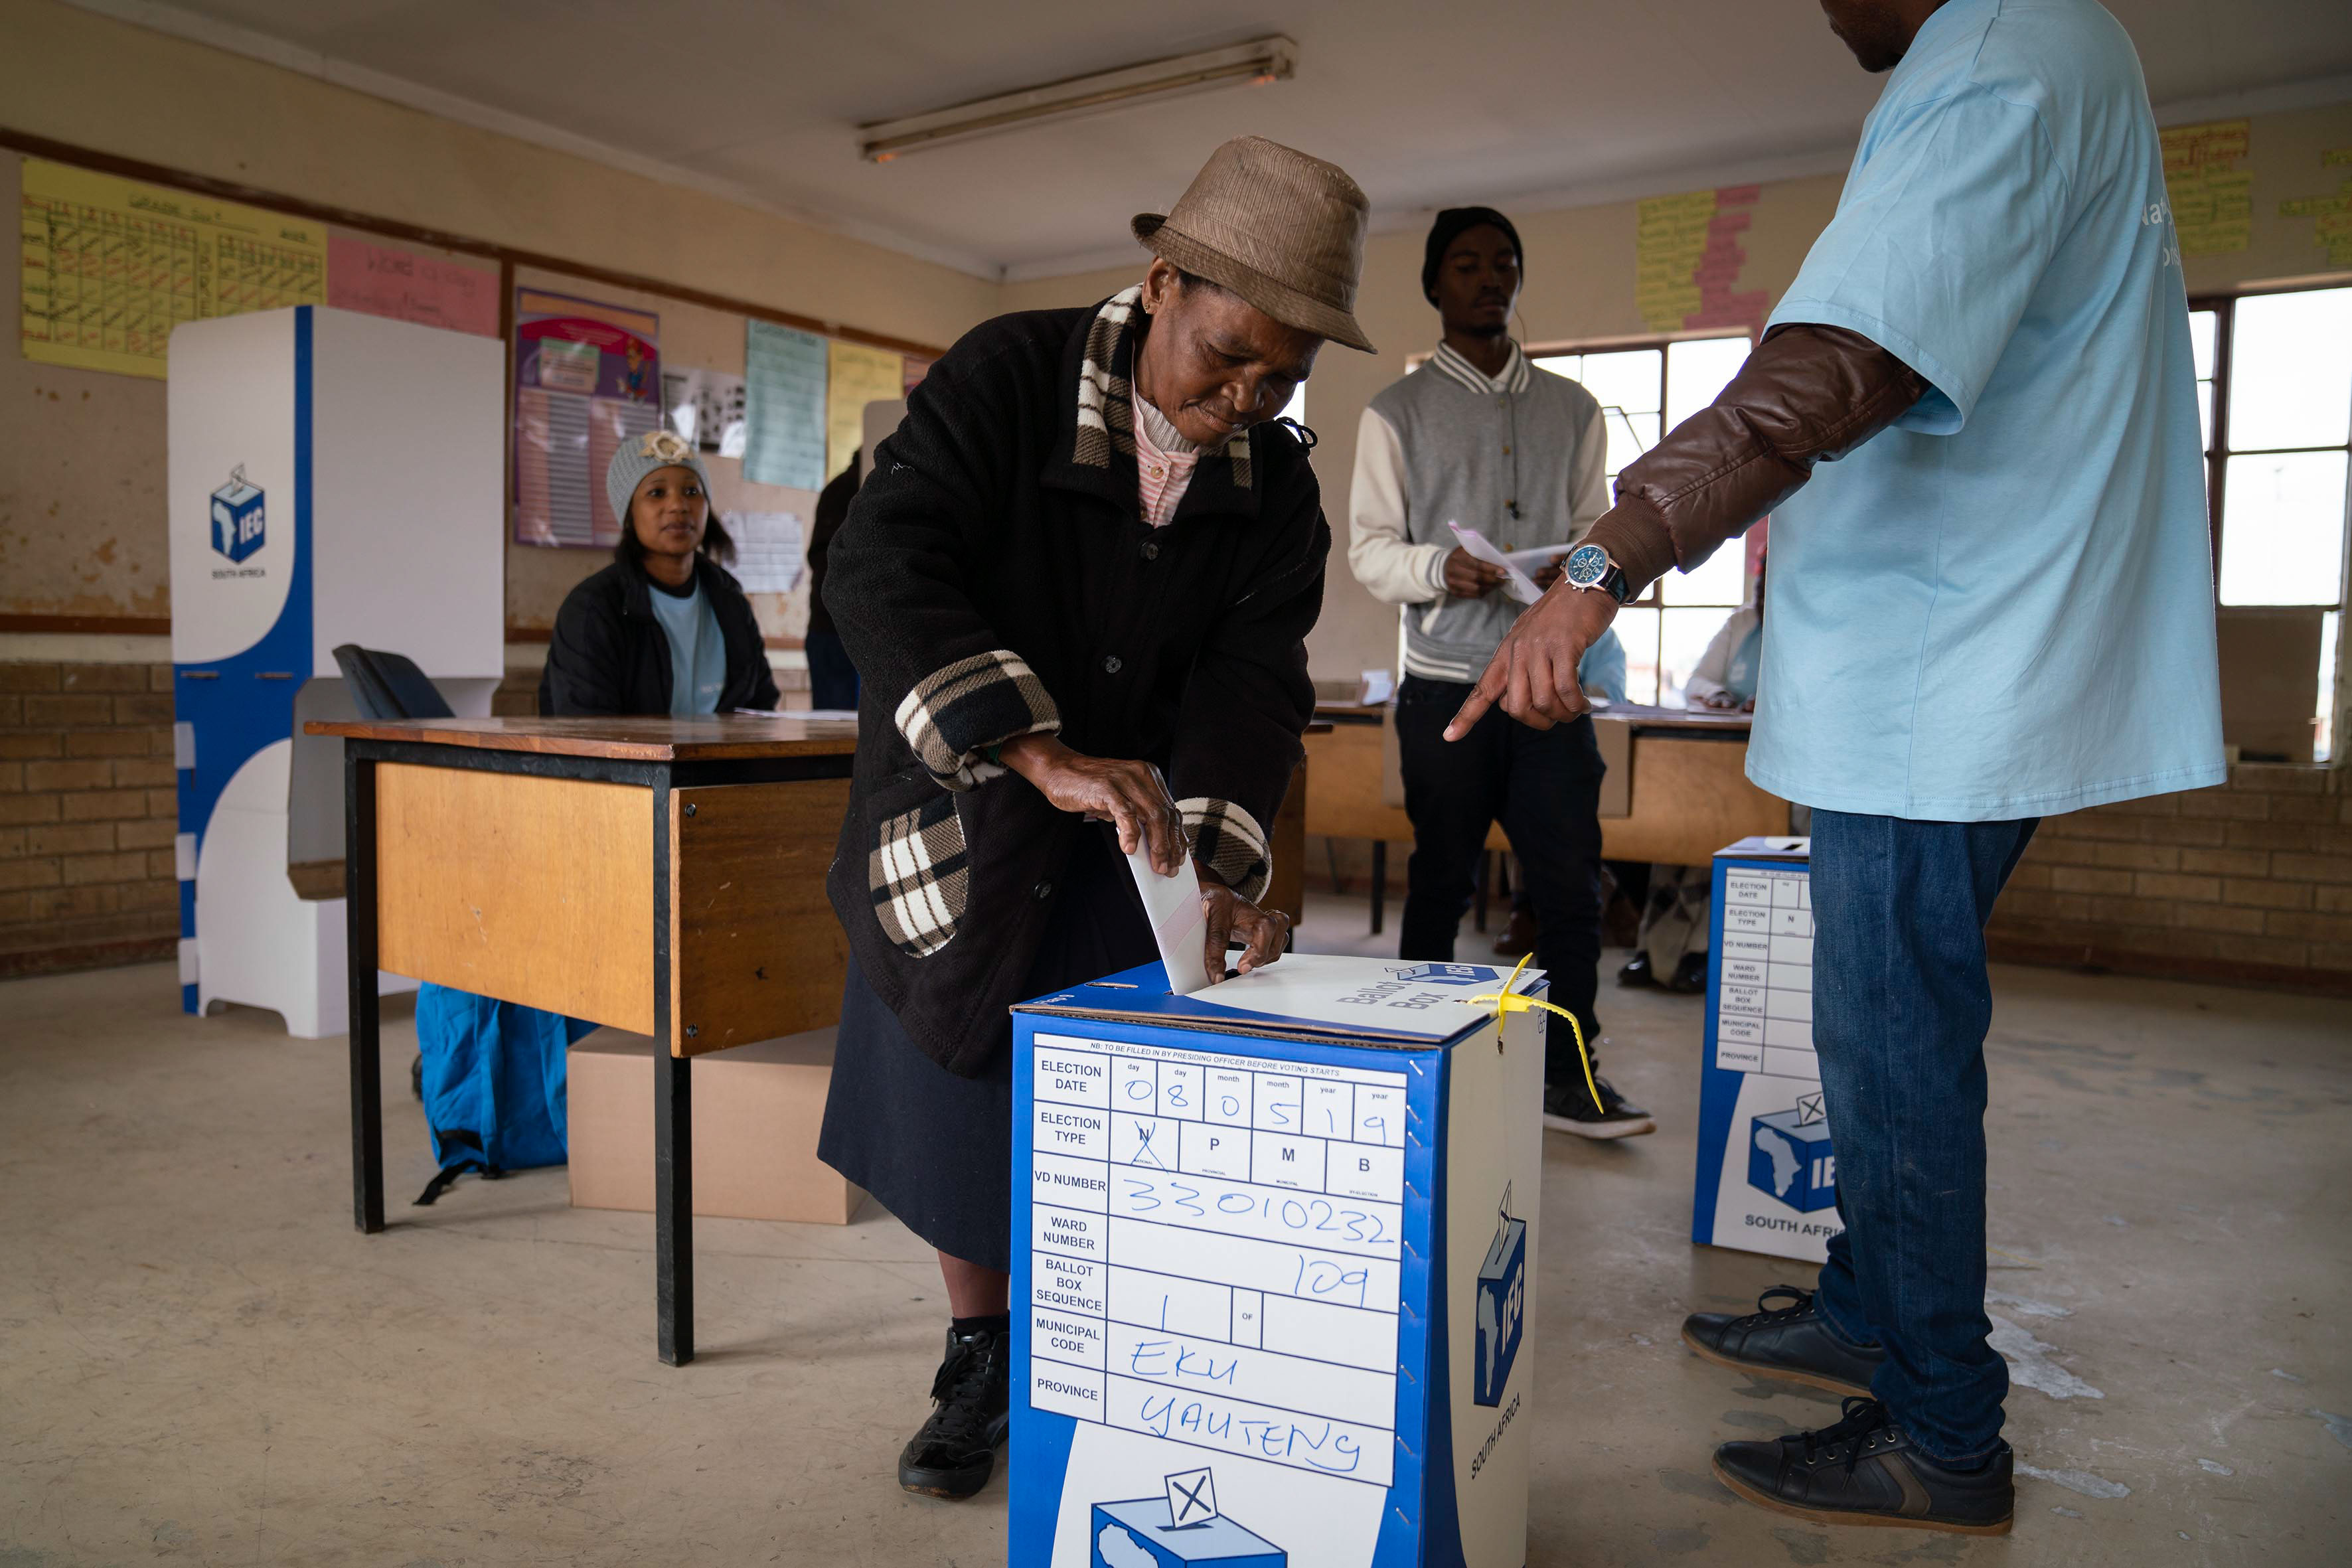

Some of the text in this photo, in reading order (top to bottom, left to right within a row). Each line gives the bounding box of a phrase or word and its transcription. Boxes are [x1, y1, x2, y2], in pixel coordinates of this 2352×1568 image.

[239, 506, 263, 544] IEC
[1731, 882, 1767, 890] ELECTION
[1736, 941, 1768, 951] NUMBER
[1445, 965, 1476, 976] IEC
[1336, 981, 1413, 1005] Ballot
[1386, 992, 1450, 1010] Box
[1729, 987, 1759, 996] BALLOT
[1723, 1004, 1763, 1014] SEQUENCE
[1721, 1019, 1761, 1029] MUNICIPAL
[1127, 1046, 1151, 1056] FILLED
[1172, 1052, 1212, 1062] PRESIDING
[1214, 1056, 1245, 1066] OFFICER
[1247, 1061, 1277, 1070] BEFORE
[1280, 1064, 1308, 1073] VOTING
[1310, 1067, 1340, 1077] STARTS
[1721, 1052, 1759, 1061] PROVINCE
[1042, 1060, 1101, 1077] ELECTION
[1128, 1063, 1140, 1072] day
[1174, 1069, 1186, 1078] day
[1217, 1074, 1240, 1083] month
[1267, 1080, 1289, 1089] month
[1056, 1079, 1087, 1092] DATE
[1041, 1112, 1101, 1130] ELECTION
[1168, 1085, 1188, 1107] 8
[1221, 1095, 1239, 1116] 0
[1270, 1103, 1300, 1124] 5
[1326, 1108, 1334, 1133] 1
[1364, 1117, 1386, 1146] 9
[1055, 1130, 1086, 1145] TYPE
[1139, 1128, 1370, 1172] N P M B
[1034, 1170, 1106, 1192] VD NUMBER
[1812, 1156, 1836, 1190] IE
[1051, 1217, 1087, 1232] WARD
[1745, 1214, 1844, 1238] SOUTH AFRI
[1044, 1231, 1095, 1250] NUMBER
[1046, 1259, 1093, 1277] BALLOT
[1056, 1277, 1082, 1291] BOX
[1295, 1255, 1368, 1308] 109
[1036, 1289, 1102, 1311] SEQUENCE
[1502, 1262, 1522, 1356] IEC
[1161, 1294, 1168, 1332] 1
[1036, 1318, 1100, 1340] MUNICIPAL
[1051, 1337, 1085, 1354] CODE
[1037, 1378, 1098, 1401] PROVINCE
[1472, 1391, 1520, 1480] SOUTH AFRICA
